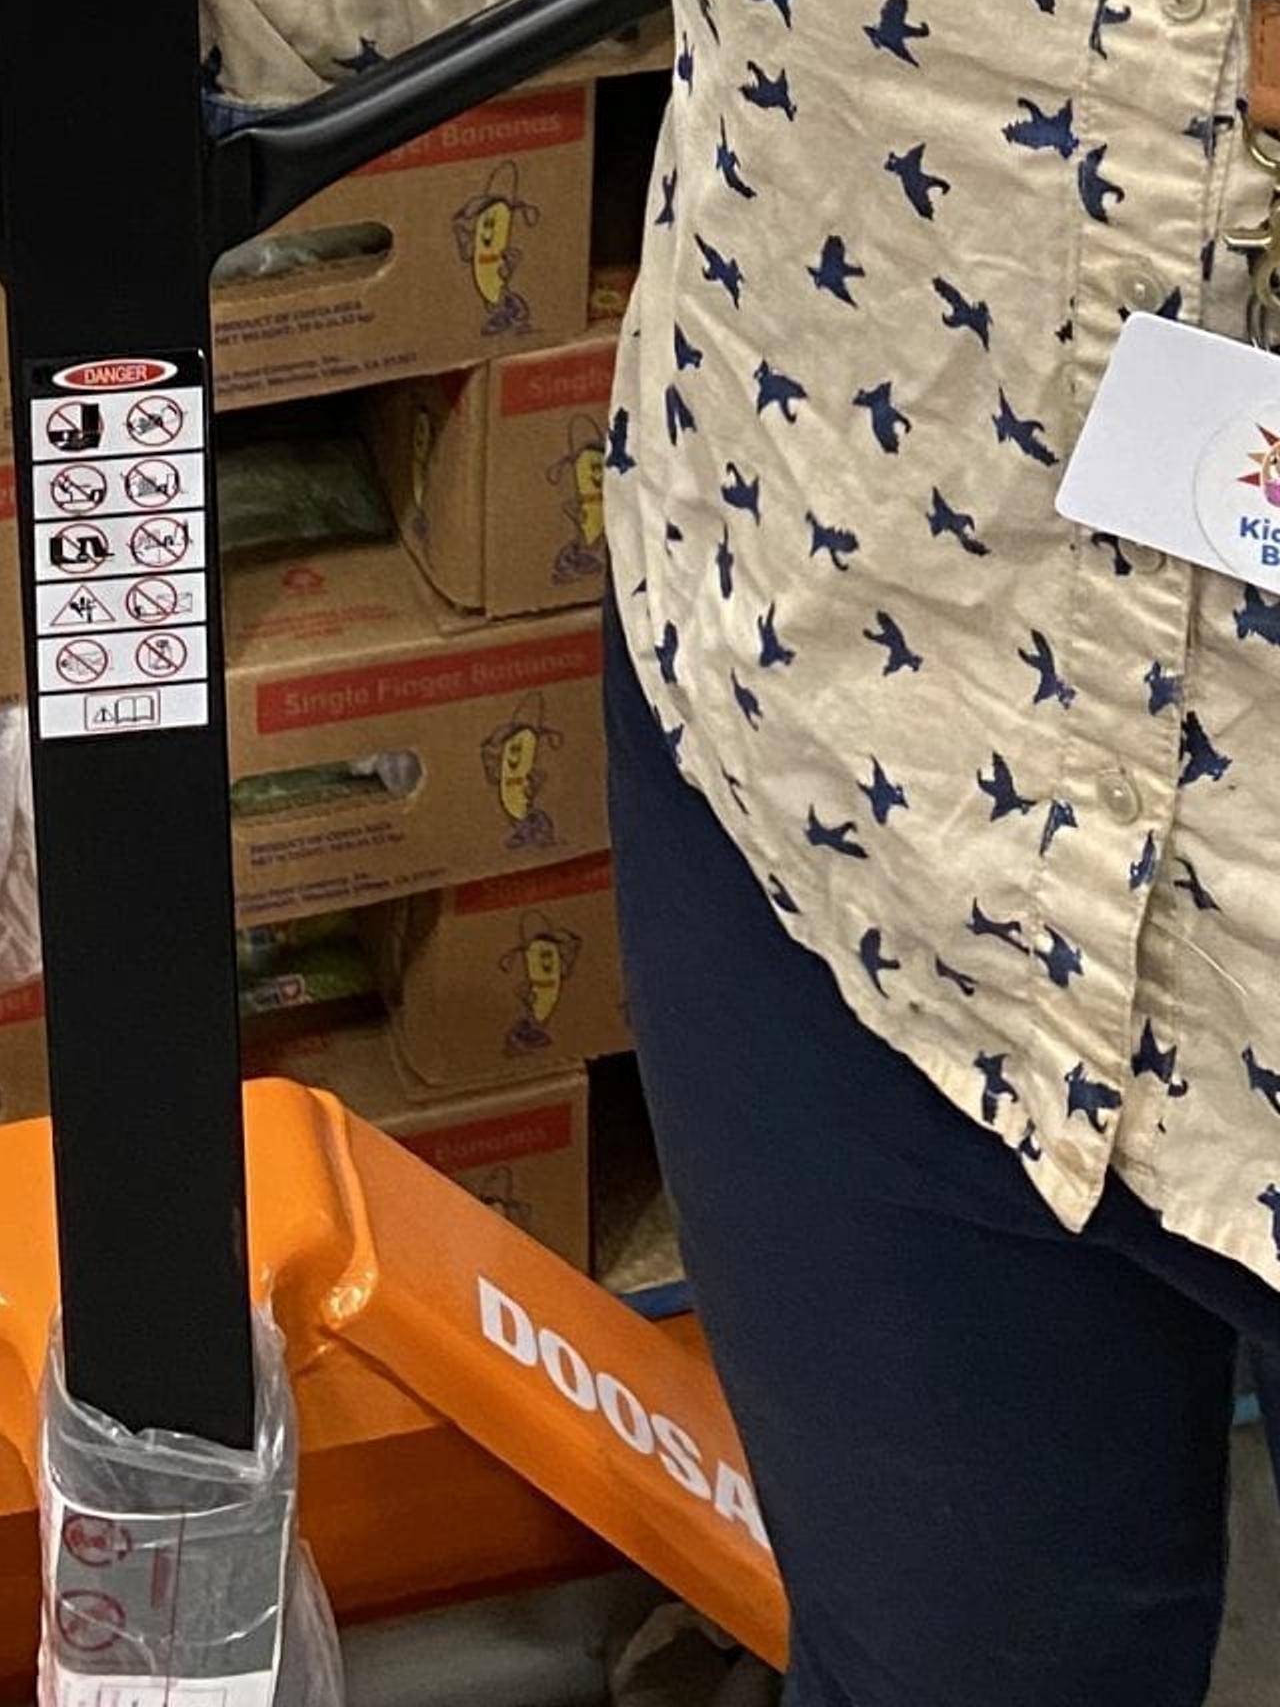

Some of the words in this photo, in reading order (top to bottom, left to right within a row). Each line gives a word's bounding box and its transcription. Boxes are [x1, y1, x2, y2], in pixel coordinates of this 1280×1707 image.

[441, 113, 562, 154] Bananas
[84, 364, 148, 385] DANGER
[284, 691, 369, 716] Single
